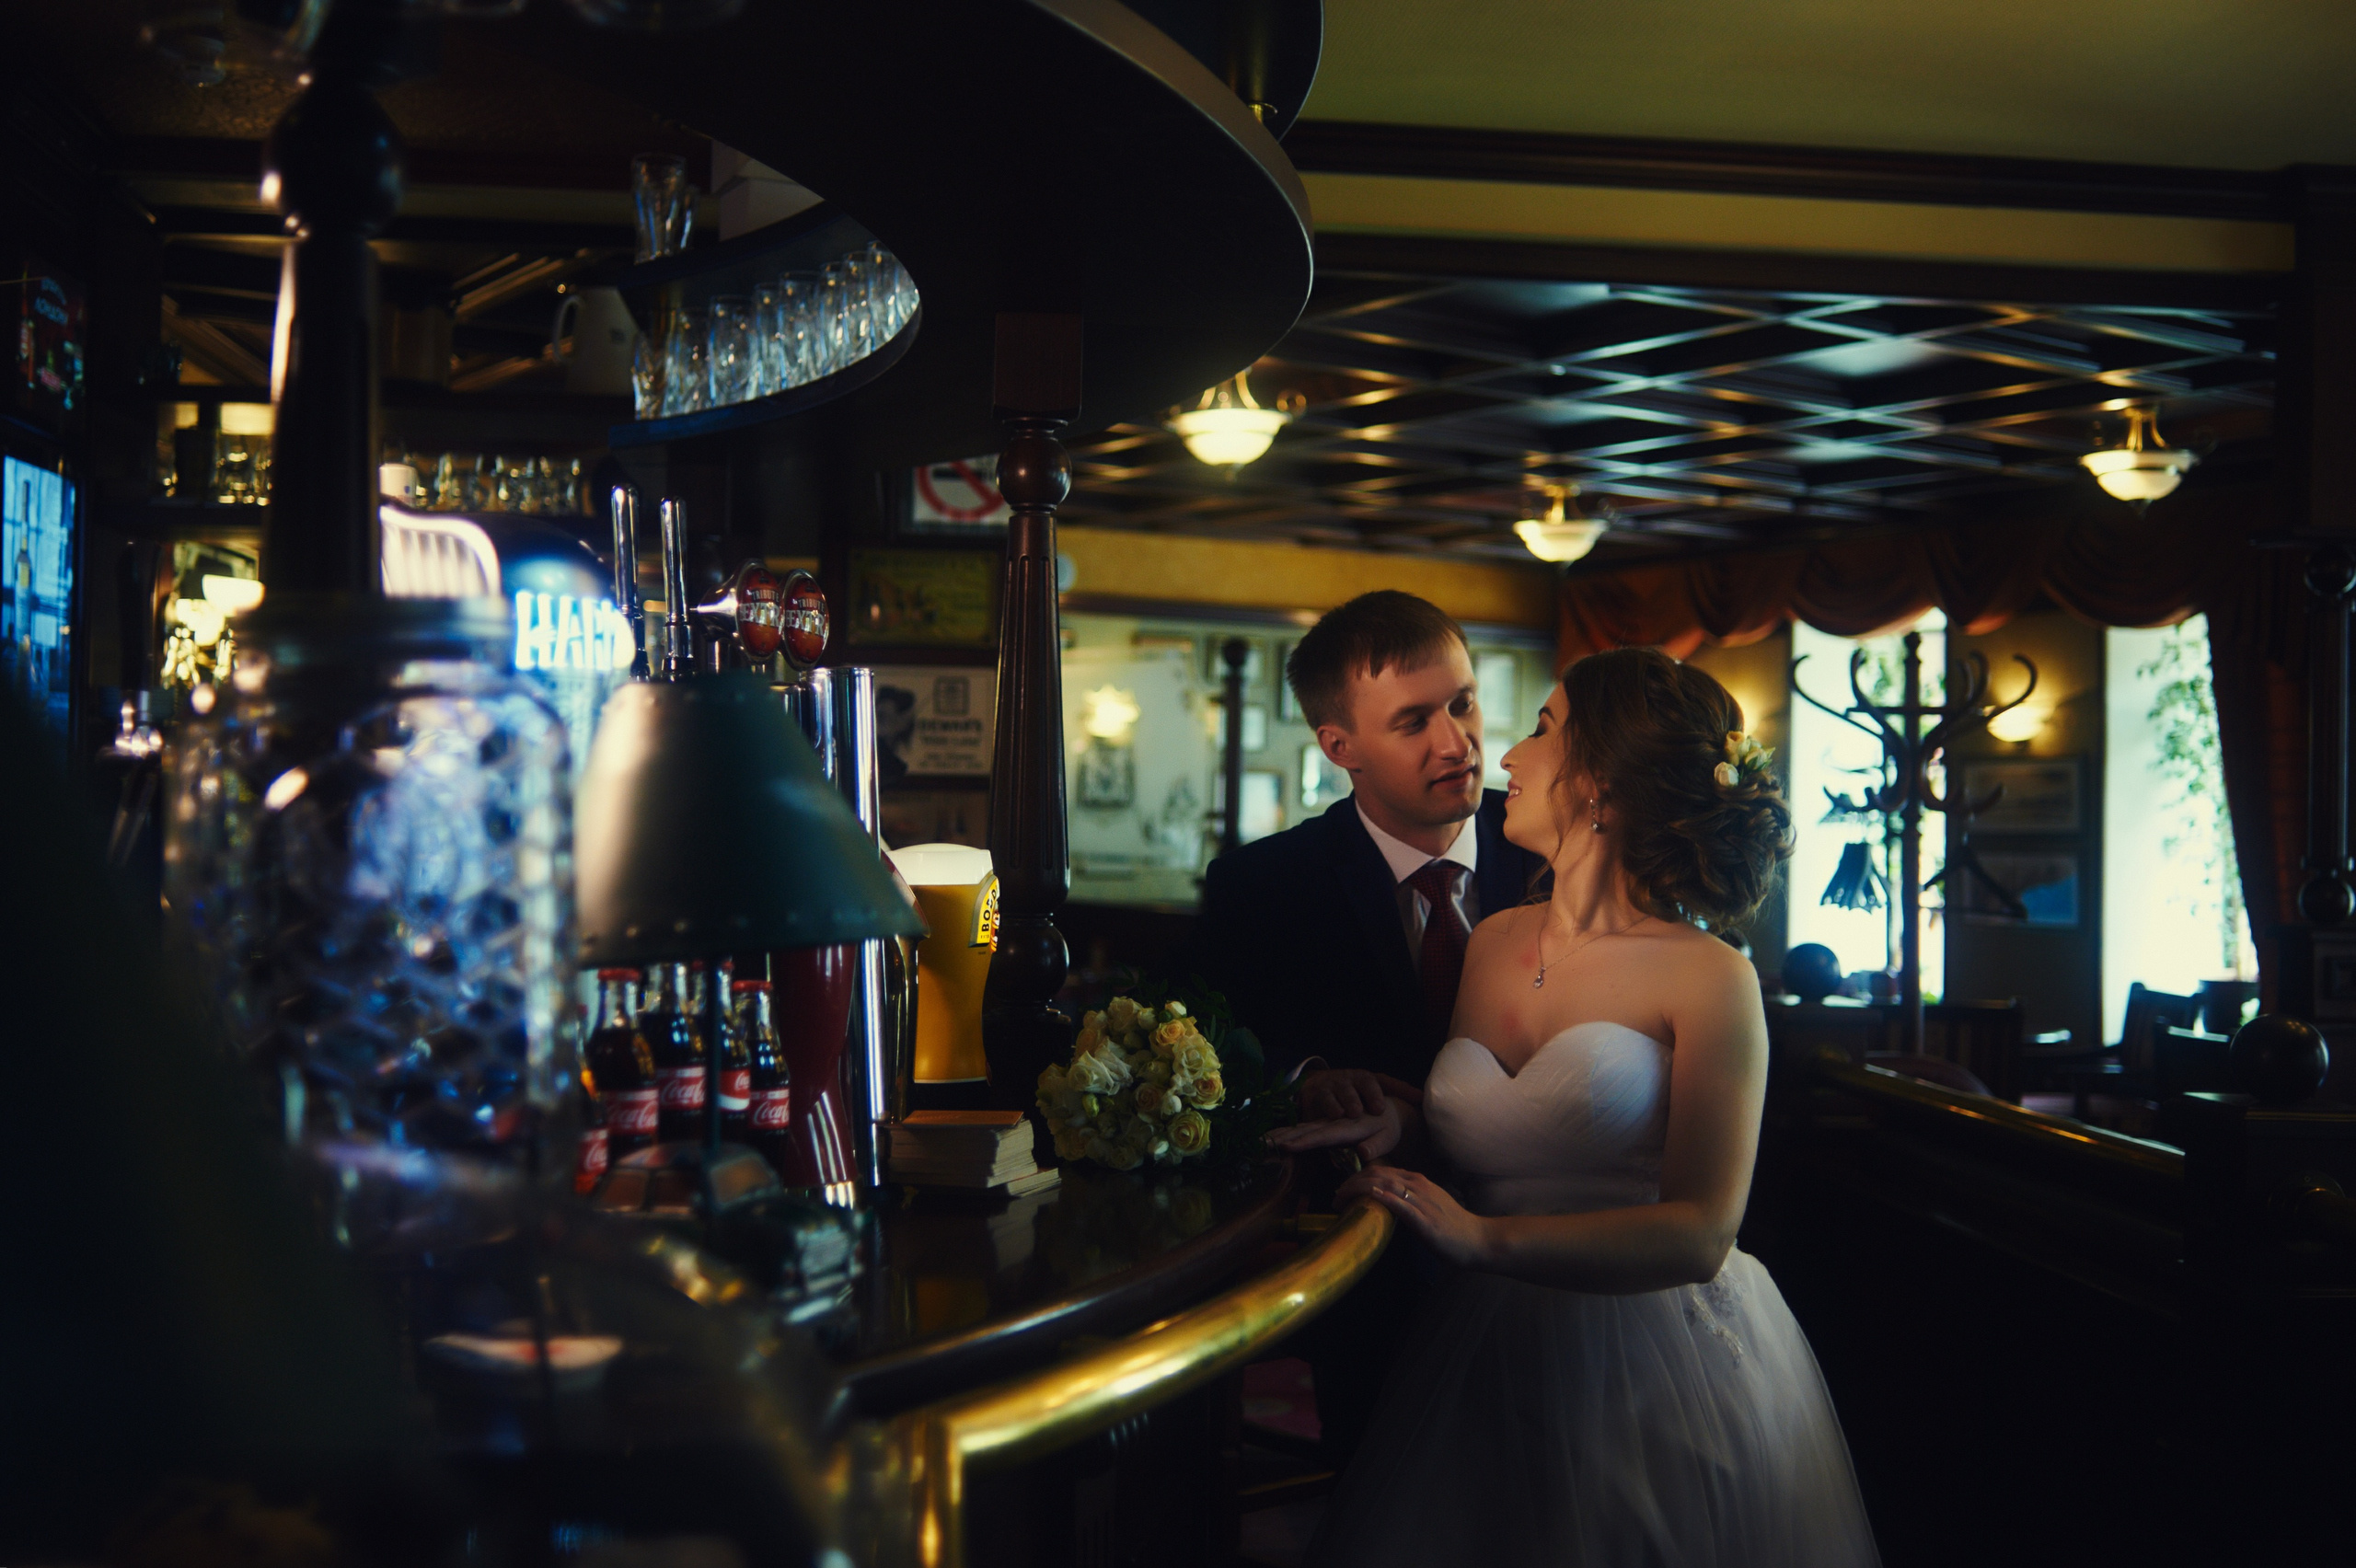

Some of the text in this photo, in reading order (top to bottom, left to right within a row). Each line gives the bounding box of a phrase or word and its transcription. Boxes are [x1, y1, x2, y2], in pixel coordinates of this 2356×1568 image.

[752, 589, 780, 603] TRIBUTE
[798, 598, 826, 612] TRIBUTE
[739, 602, 782, 629] EXTR
[785, 609, 828, 640] EXTR
